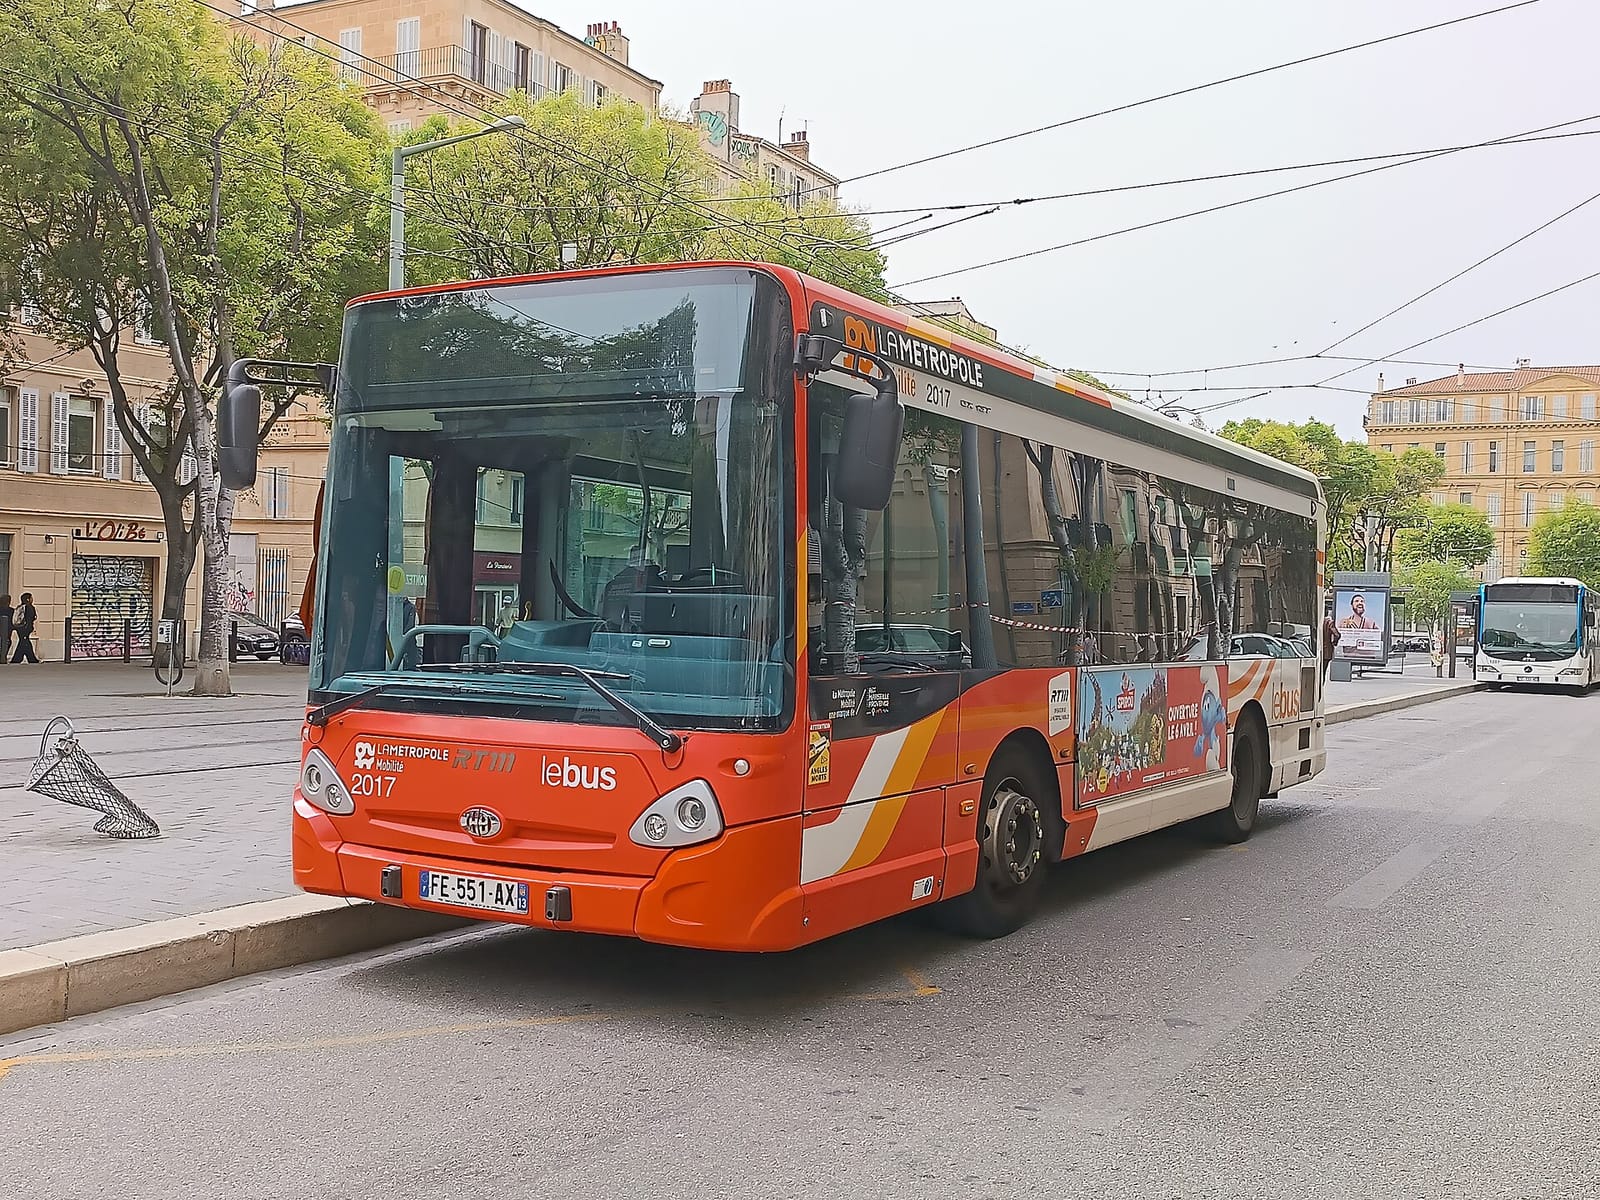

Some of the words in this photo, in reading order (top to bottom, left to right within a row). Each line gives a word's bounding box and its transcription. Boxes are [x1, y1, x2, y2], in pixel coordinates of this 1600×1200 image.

[877, 327, 983, 388] LAMETROPOLE
[926, 383, 951, 409] 2017
[1050, 689, 1069, 703] RTM
[1117, 696, 1135, 709] SPIROU
[1271, 682, 1299, 720] lebus
[1168, 703, 1199, 721] OUVERTURE
[1168, 726, 1175, 740] LE
[1175, 726, 1180, 739] 6
[1179, 723, 1194, 738] AVRIL
[377, 743, 449, 761] LAMETROPOLE
[375, 758, 405, 773] Mobilité
[452, 749, 516, 774] RTM
[811, 765, 828, 774] ANGLES
[541, 754, 617, 791] lebus
[811, 773, 827, 783] MORTS
[350, 774, 397, 797] 2017
[431, 873, 515, 906] FE-551-AX
[518, 896, 527, 908] 13
